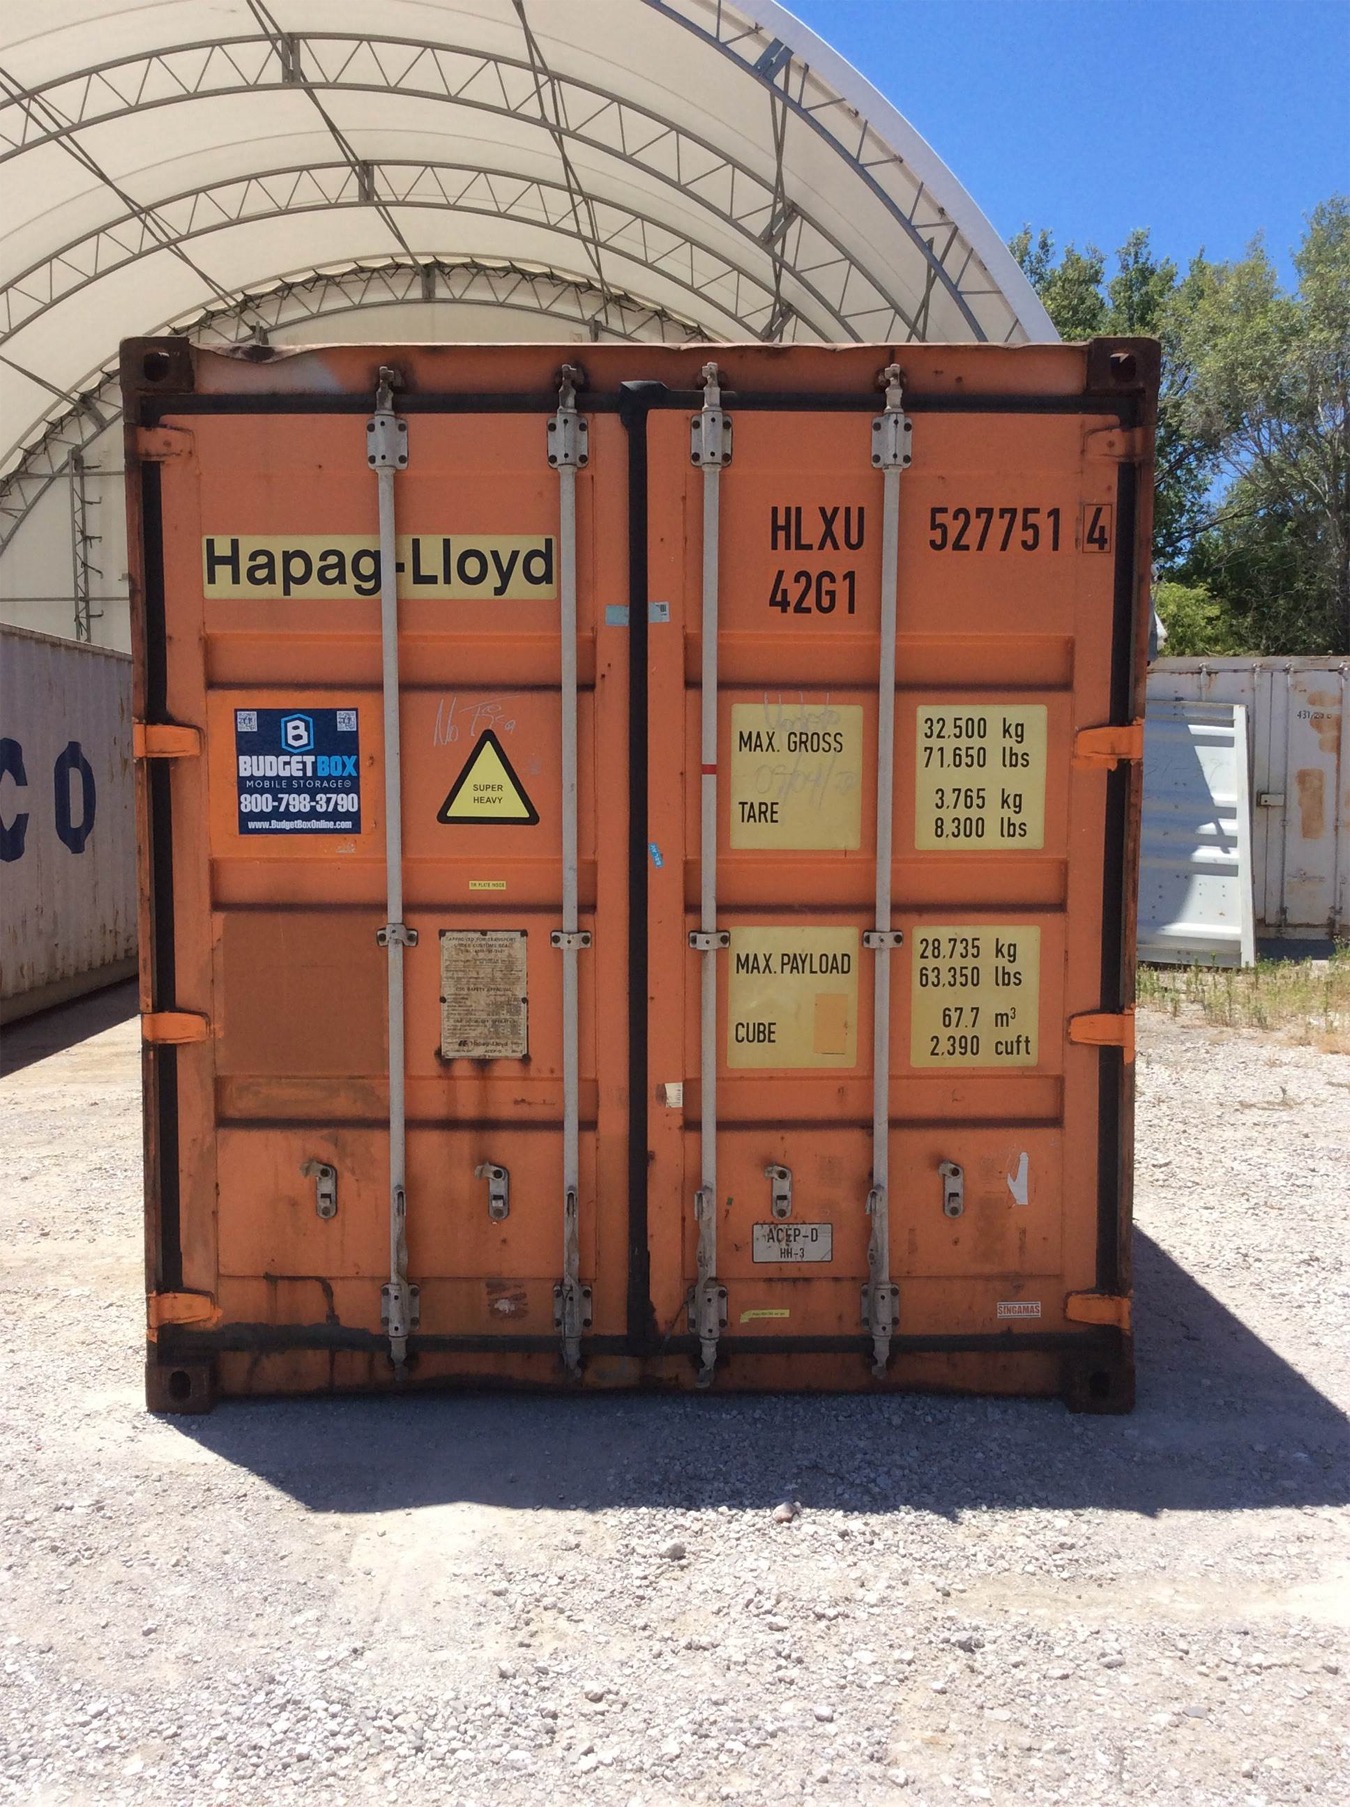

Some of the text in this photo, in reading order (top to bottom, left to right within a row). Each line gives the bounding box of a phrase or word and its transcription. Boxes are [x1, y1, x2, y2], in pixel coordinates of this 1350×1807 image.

[770, 506, 1109, 552] HLXU 527751 4
[768, 569, 856, 615] 42G1
[738, 730, 843, 753] MAX. GROSS
[924, 717, 1025, 744] 32,500 kg
[238, 755, 358, 777] BUDGET BOX
[923, 746, 1030, 768] 71,650 lbs
[246, 780, 287, 788] MOBILE
[472, 784, 504, 792] SUPER
[240, 793, 359, 813] 800-798-3790
[473, 796, 503, 804] HEAVY
[1000, 787, 1023, 815] kg
[738, 801, 780, 824] TARE
[247, 819, 353, 831] www.BudgetBoxOnline.com
[1000, 816, 1027, 838] lbs
[919, 937, 1017, 963] 28,735 kg
[735, 953, 851, 975] MAX. PAYLOAD
[919, 966, 1023, 988] 63,350 lbs
[942, 1006, 980, 1029] 67.7
[735, 1022, 777, 1044] CUBE
[994, 1034, 1031, 1056] cuft
[767, 1228, 819, 1243] ACEP-D
[780, 1248, 805, 1259] HH-3
[998, 1304, 1040, 1315] SINGAMAS
